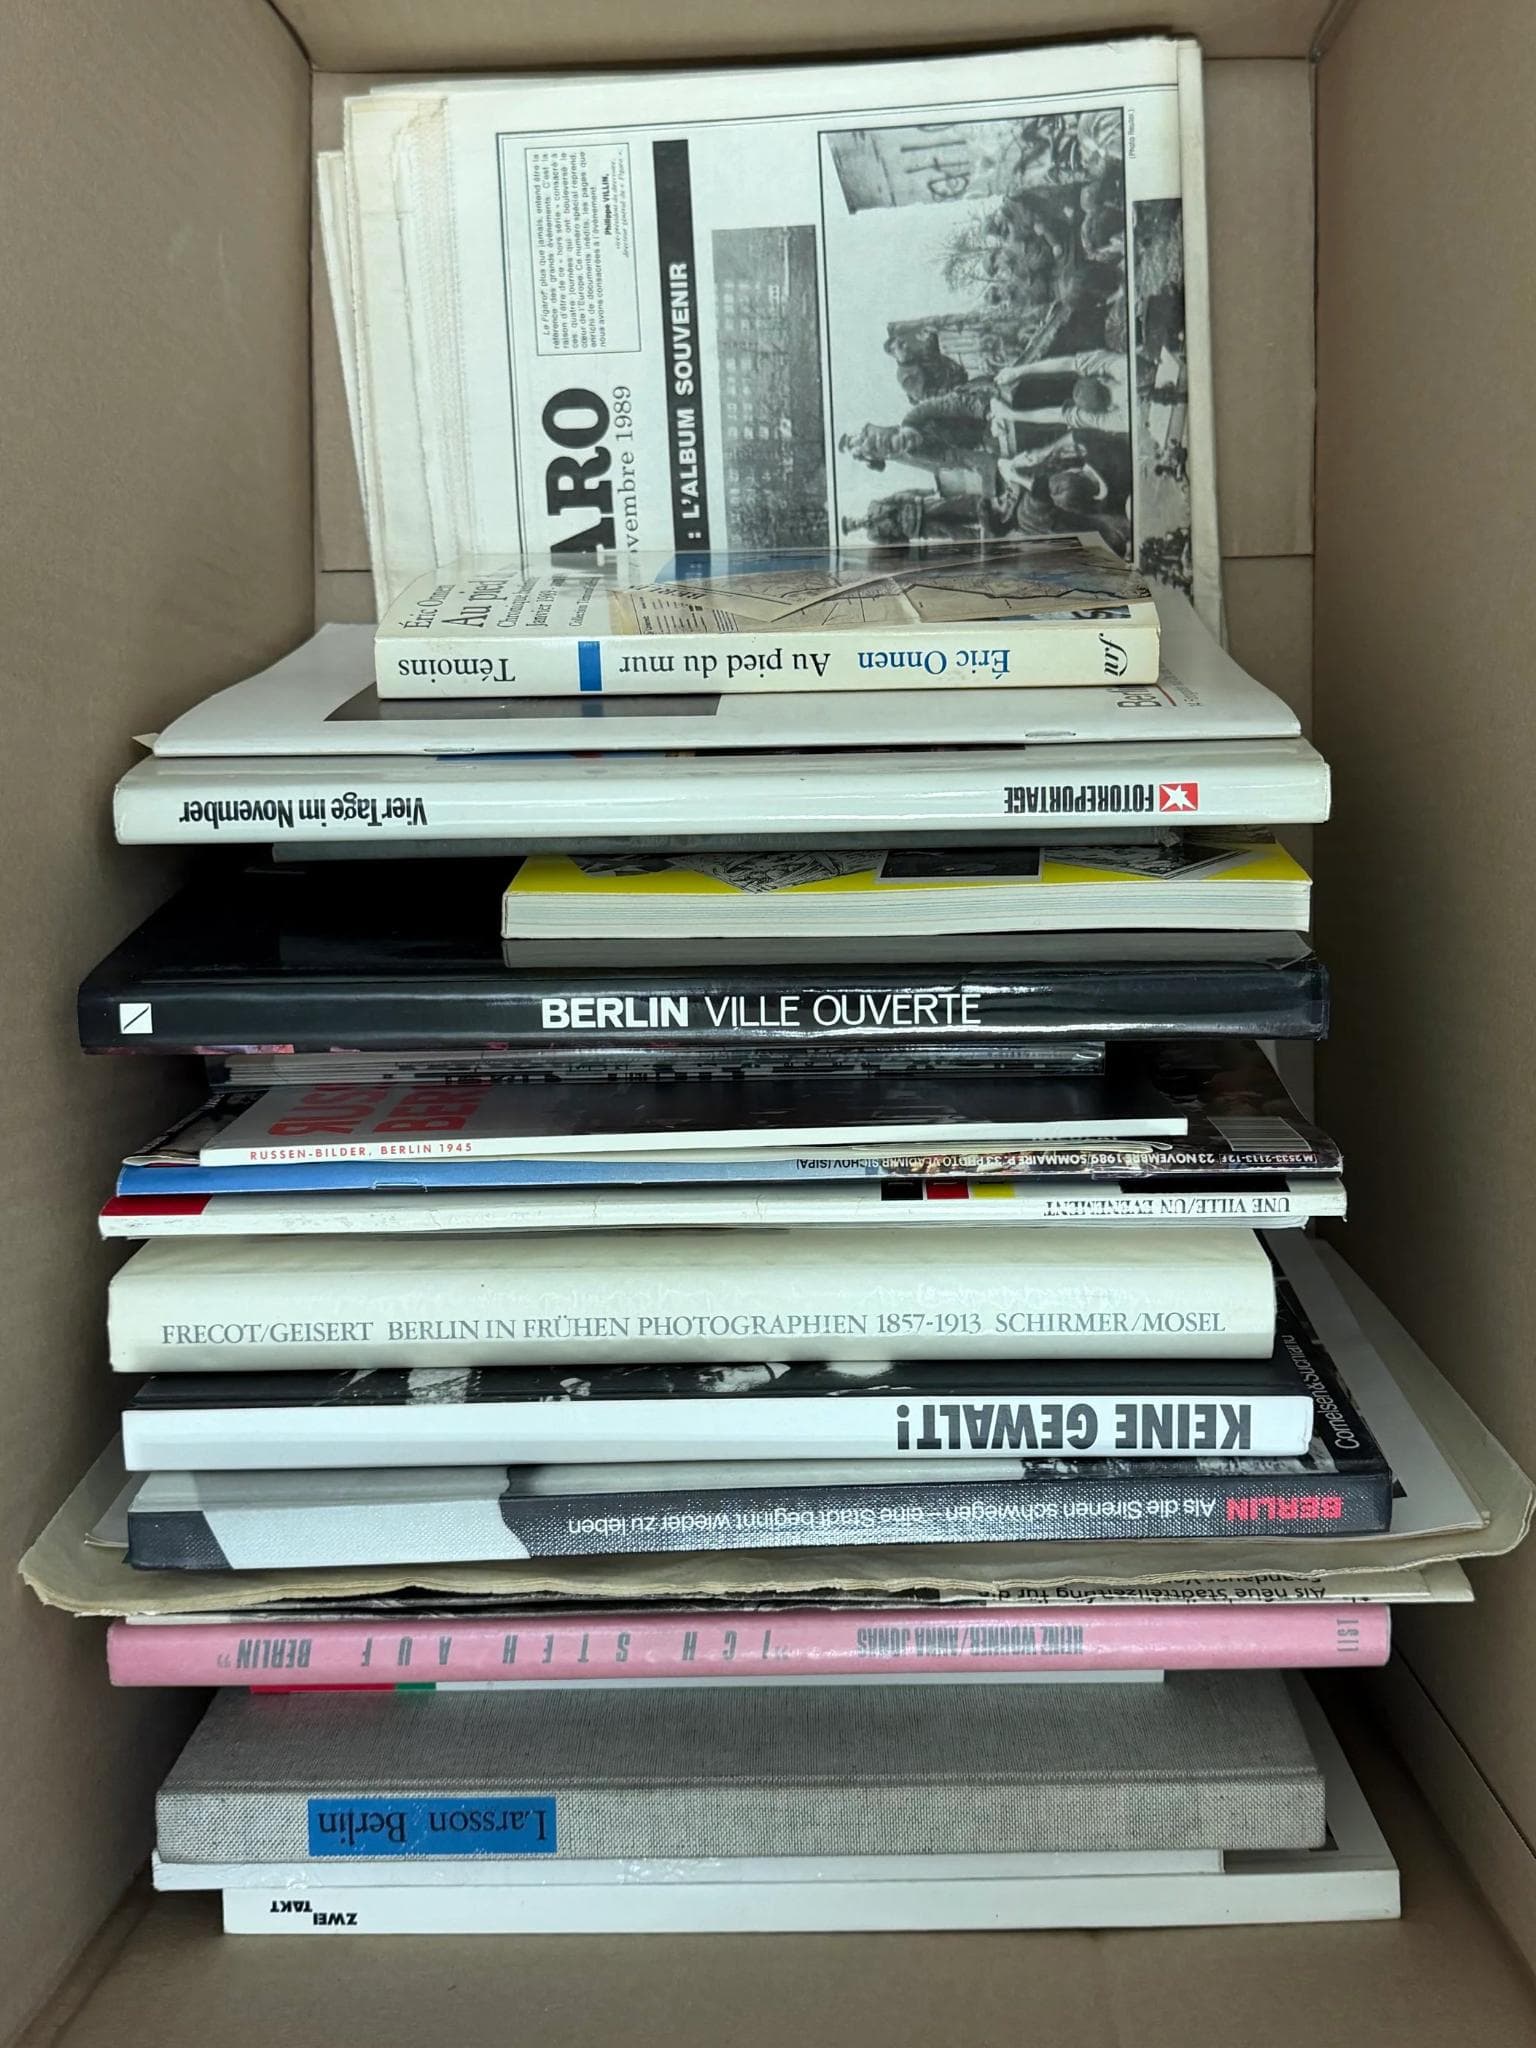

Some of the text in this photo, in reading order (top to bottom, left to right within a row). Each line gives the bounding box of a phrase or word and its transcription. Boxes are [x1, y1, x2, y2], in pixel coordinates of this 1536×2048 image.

[668, 262, 698, 396] SOUVENIR
[612, 386, 635, 442] 1989
[676, 408, 701, 520] L'ALBUM
[459, 580, 508, 602] pied
[398, 609, 438, 629] Éric
[441, 606, 492, 628] Au
[525, 604, 552, 628] Janvier
[397, 643, 1011, 685] Éric Onnen Au pied du mur Témoins
[178, 792, 428, 829] Vier Tage im November
[1004, 784, 1155, 815] FOTOREPORTAGE
[541, 992, 982, 1030] BERLIN VILLE OUVERTE
[379, 1143, 434, 1159] BERLIN
[439, 1141, 473, 1156] 1945
[796, 1157, 832, 1171] (SIPA)
[1159, 1197, 1247, 1217] VILLE/UN
[1249, 1196, 1291, 1215] UNE
[161, 1310, 1226, 1346] FRECOT/GEISERT BERLIN IN FRÜHEN PHOTOGRAPHIEN 1857-1913 SCHIRMER/MOSEL
[896, 1402, 1252, 1451] KEINE GEWALT!
[880, 1506, 923, 1524] eine
[944, 1502, 1059, 1525] schwiegen
[1063, 1500, 1142, 1519] Sirenen
[1146, 1499, 1181, 1517] die
[1184, 1498, 1216, 1514] Als
[1225, 1495, 1344, 1521] BERLIN
[568, 1516, 627, 1537] leben
[631, 1516, 656, 1534] zu
[661, 1512, 733, 1533] wieder
[734, 1507, 815, 1530] beginnt
[816, 1508, 875, 1528] Stadt
[857, 1625, 911, 1657] JONAS
[317, 1809, 548, 1845] Larsson Berlin
[269, 1899, 313, 1913] TAKT
[312, 1912, 358, 1926] ZWEI
